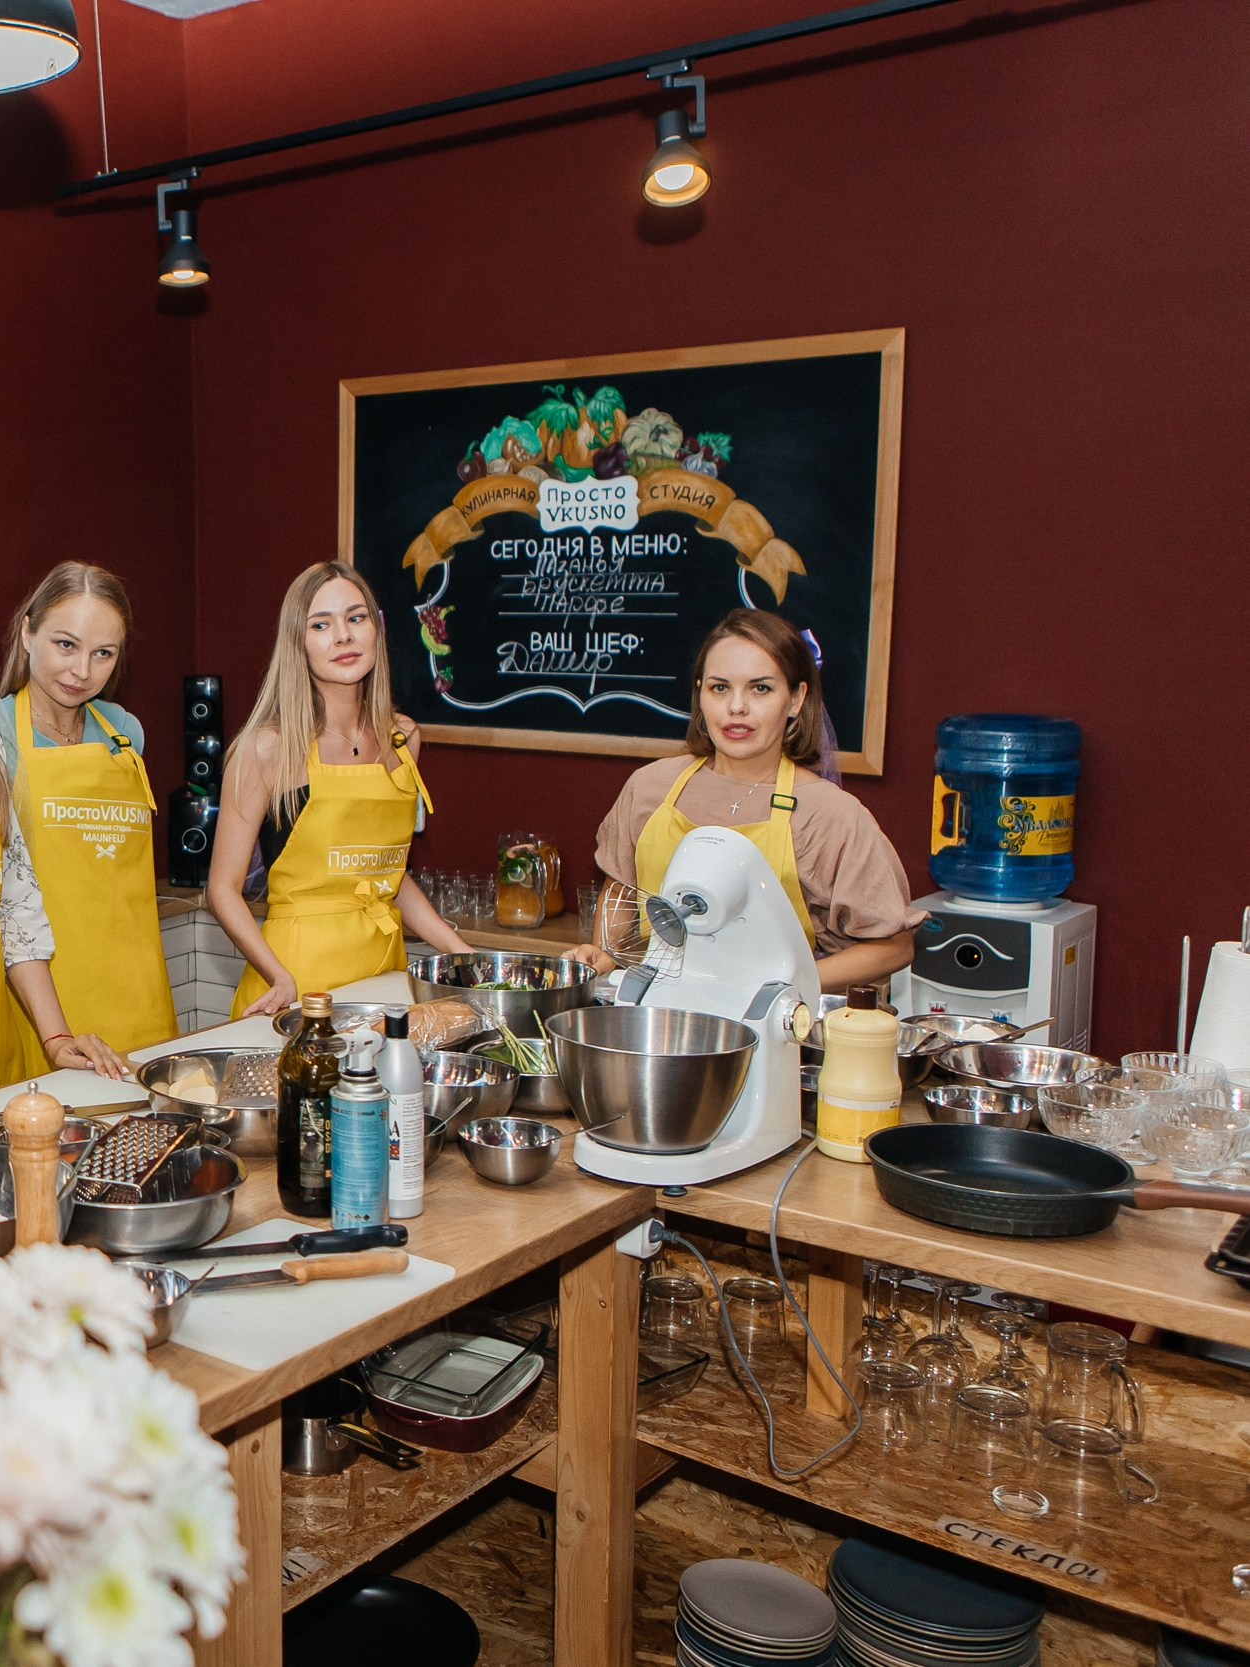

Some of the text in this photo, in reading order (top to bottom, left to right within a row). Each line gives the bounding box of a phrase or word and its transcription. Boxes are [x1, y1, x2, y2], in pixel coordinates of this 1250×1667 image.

[461, 483, 716, 518] КУЛИНАРНАЯ СТУДИЯ
[547, 486, 627, 505] Просто
[546, 504, 626, 522] VKUSNO
[491, 533, 688, 560] СЕГОДНЯ В МЕНЮ:
[530, 631, 645, 655] ВАШ ШЕФ:
[43, 801, 151, 825] ПростоVKUSNO
[83, 832, 126, 843] MAUNFELD
[944, 1522, 1100, 1580] СТЕКЛО!
